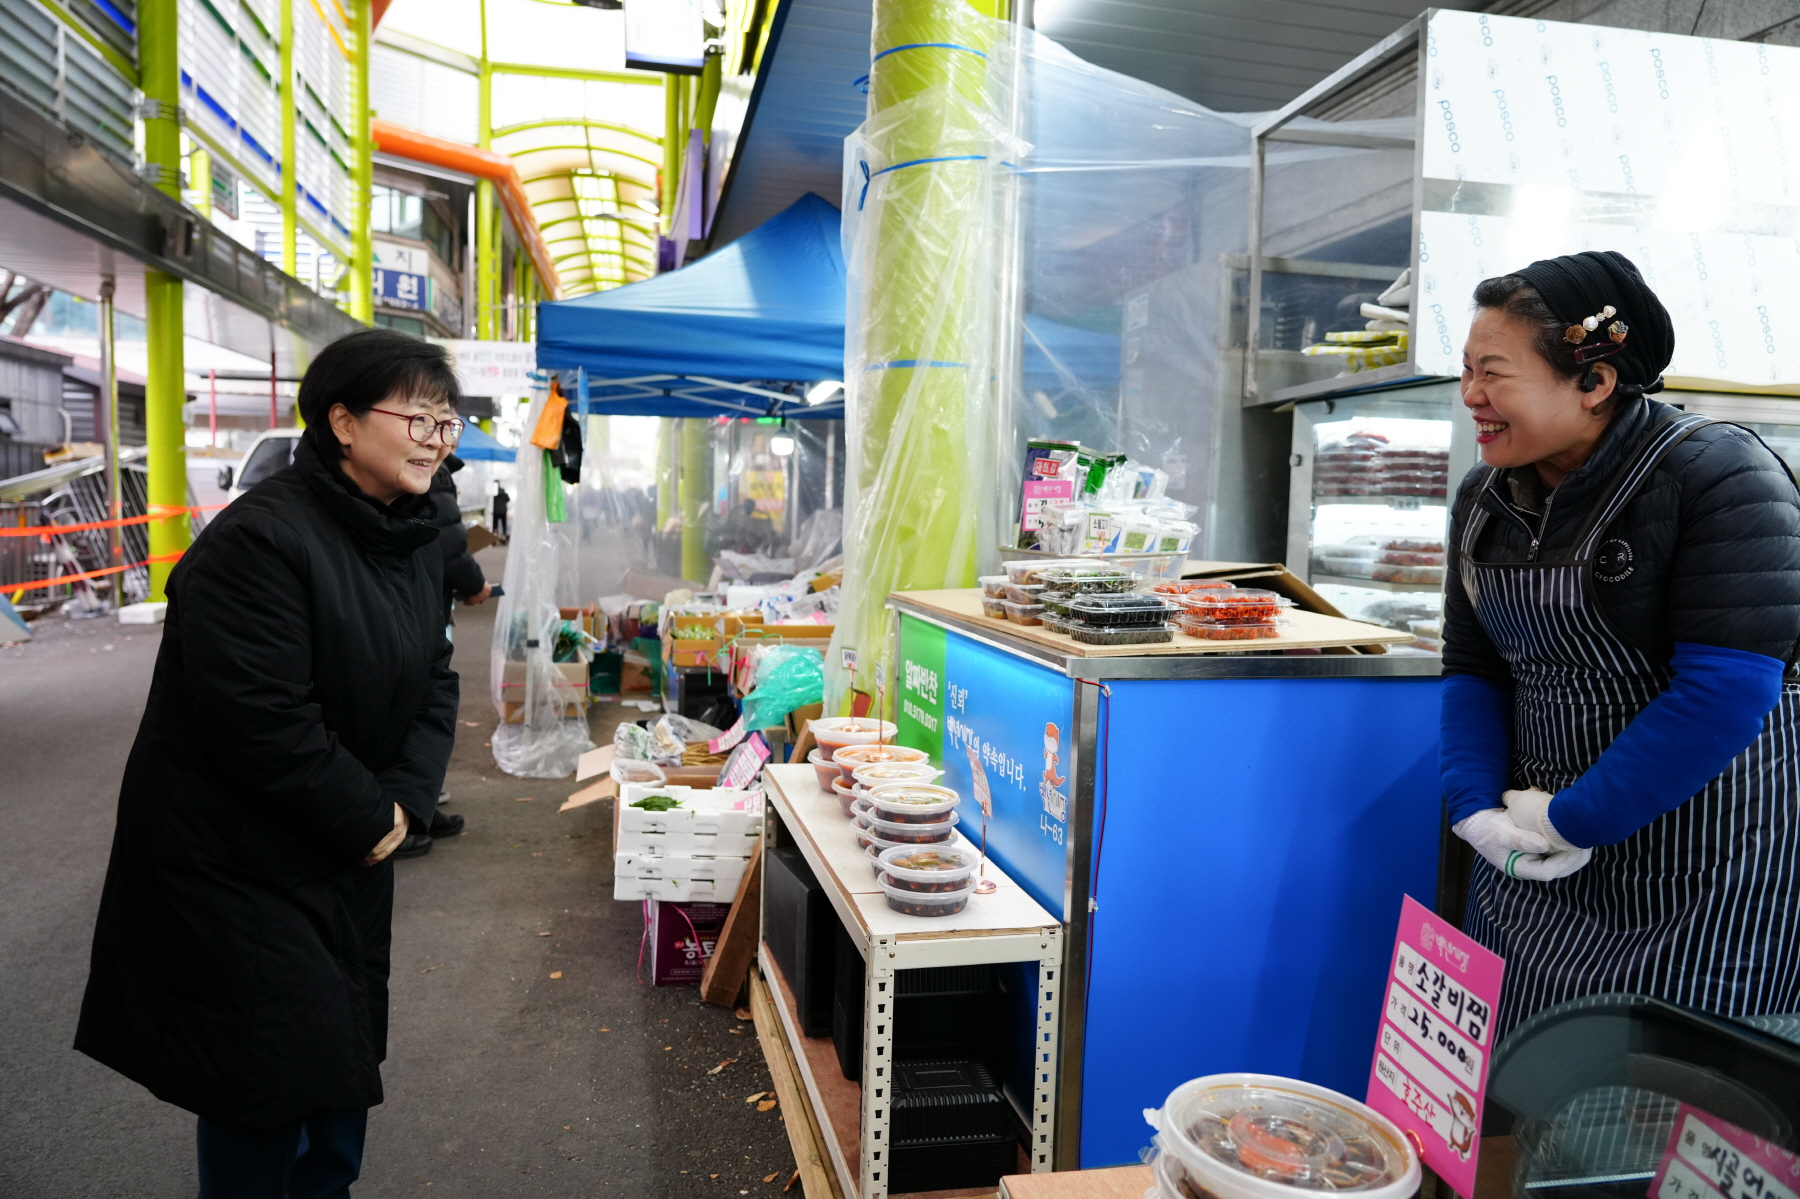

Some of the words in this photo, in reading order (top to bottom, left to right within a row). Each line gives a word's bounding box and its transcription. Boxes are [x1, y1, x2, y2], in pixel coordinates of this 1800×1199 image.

[1597, 61, 1618, 113] posco
[1649, 48, 1669, 99] posco
[1438, 100, 1460, 153] posco
[1493, 89, 1514, 142] posco
[1546, 75, 1567, 127] posco
[1689, 231, 1708, 281] posco
[1429, 303, 1453, 355] posco
[1708, 320, 1727, 369] posco
[1756, 305, 1775, 354] posco
[1594, 566, 1635, 583] CROCODILE
[982, 741, 1027, 792] 약속입니다.
[1040, 813, 1064, 846] 나-63
[1415, 961, 1489, 1041] 소갈비찜
[1377, 1059, 1396, 1085] 원산지
[1401, 1076, 1437, 1129] 호주산
